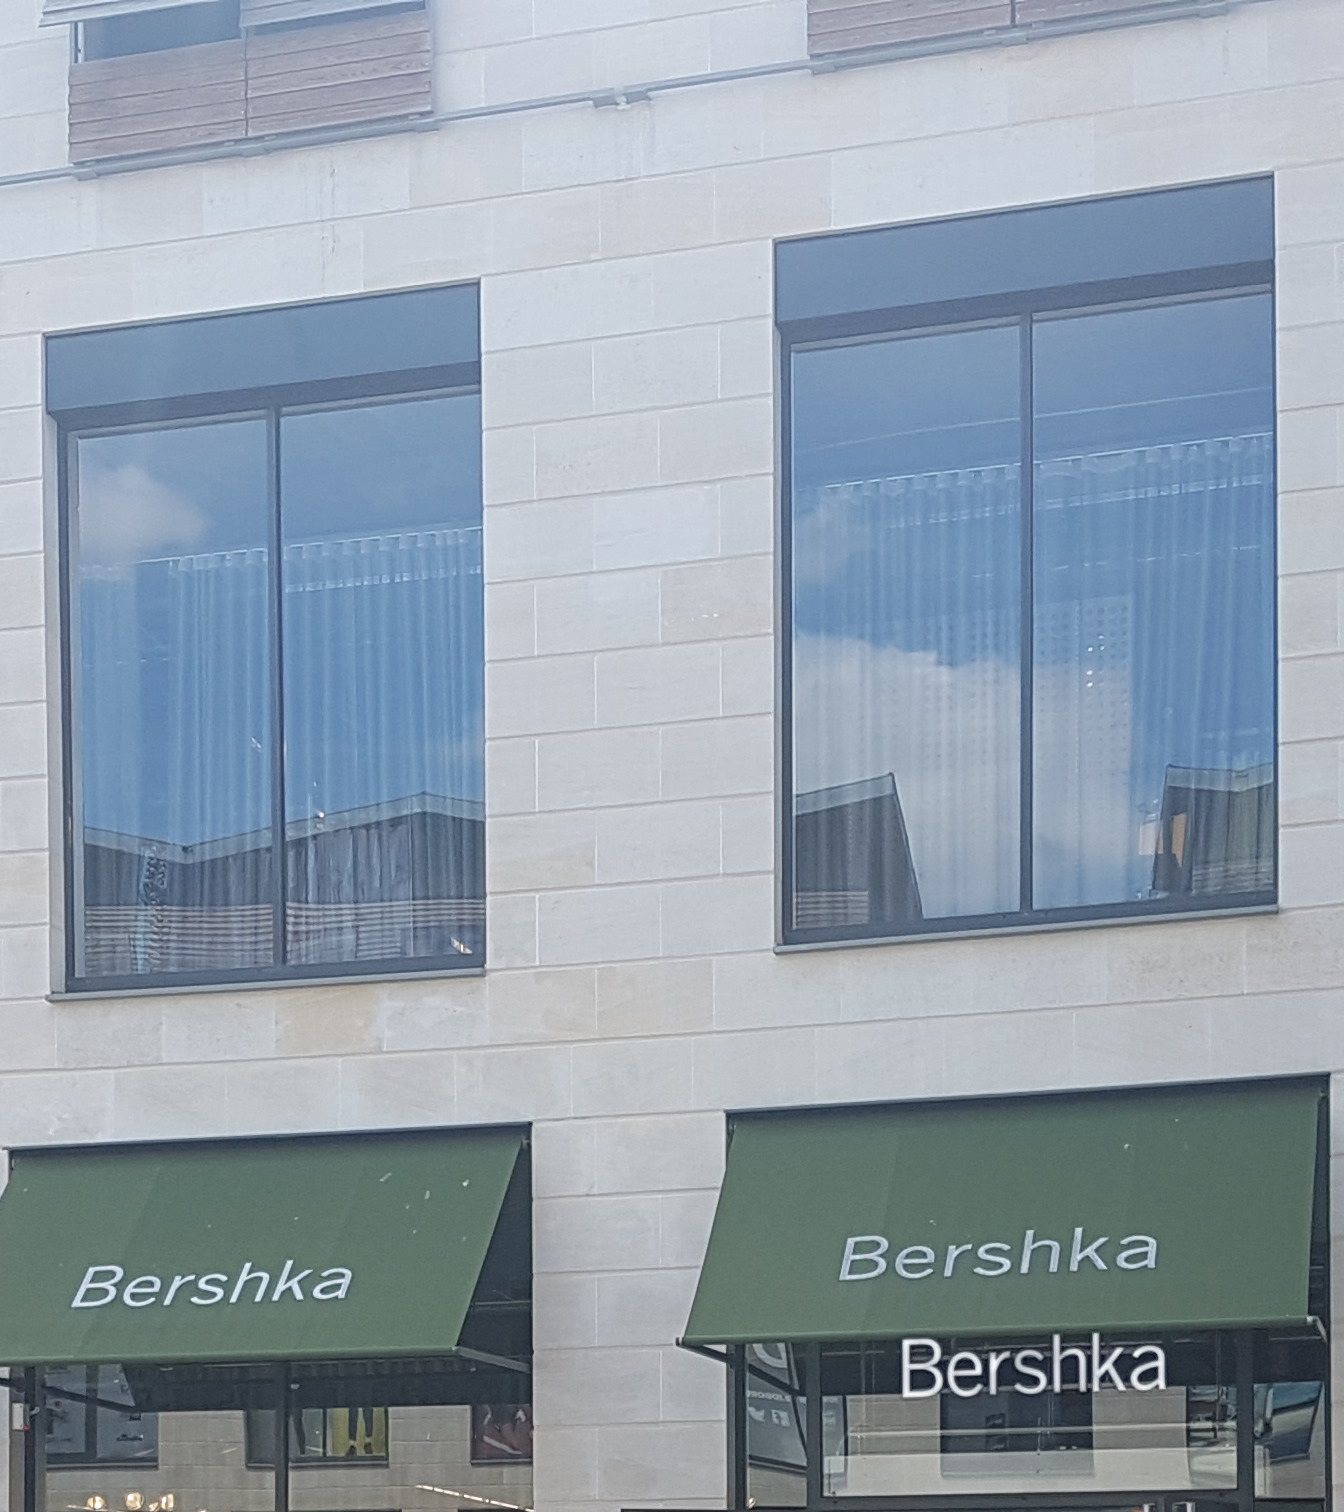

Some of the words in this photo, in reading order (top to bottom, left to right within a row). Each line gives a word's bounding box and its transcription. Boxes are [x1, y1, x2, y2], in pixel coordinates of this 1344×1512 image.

[839, 1227, 1158, 1281] Bershka
[71, 1259, 353, 1308] Bershka
[901, 1332, 1168, 1399] Bershka
